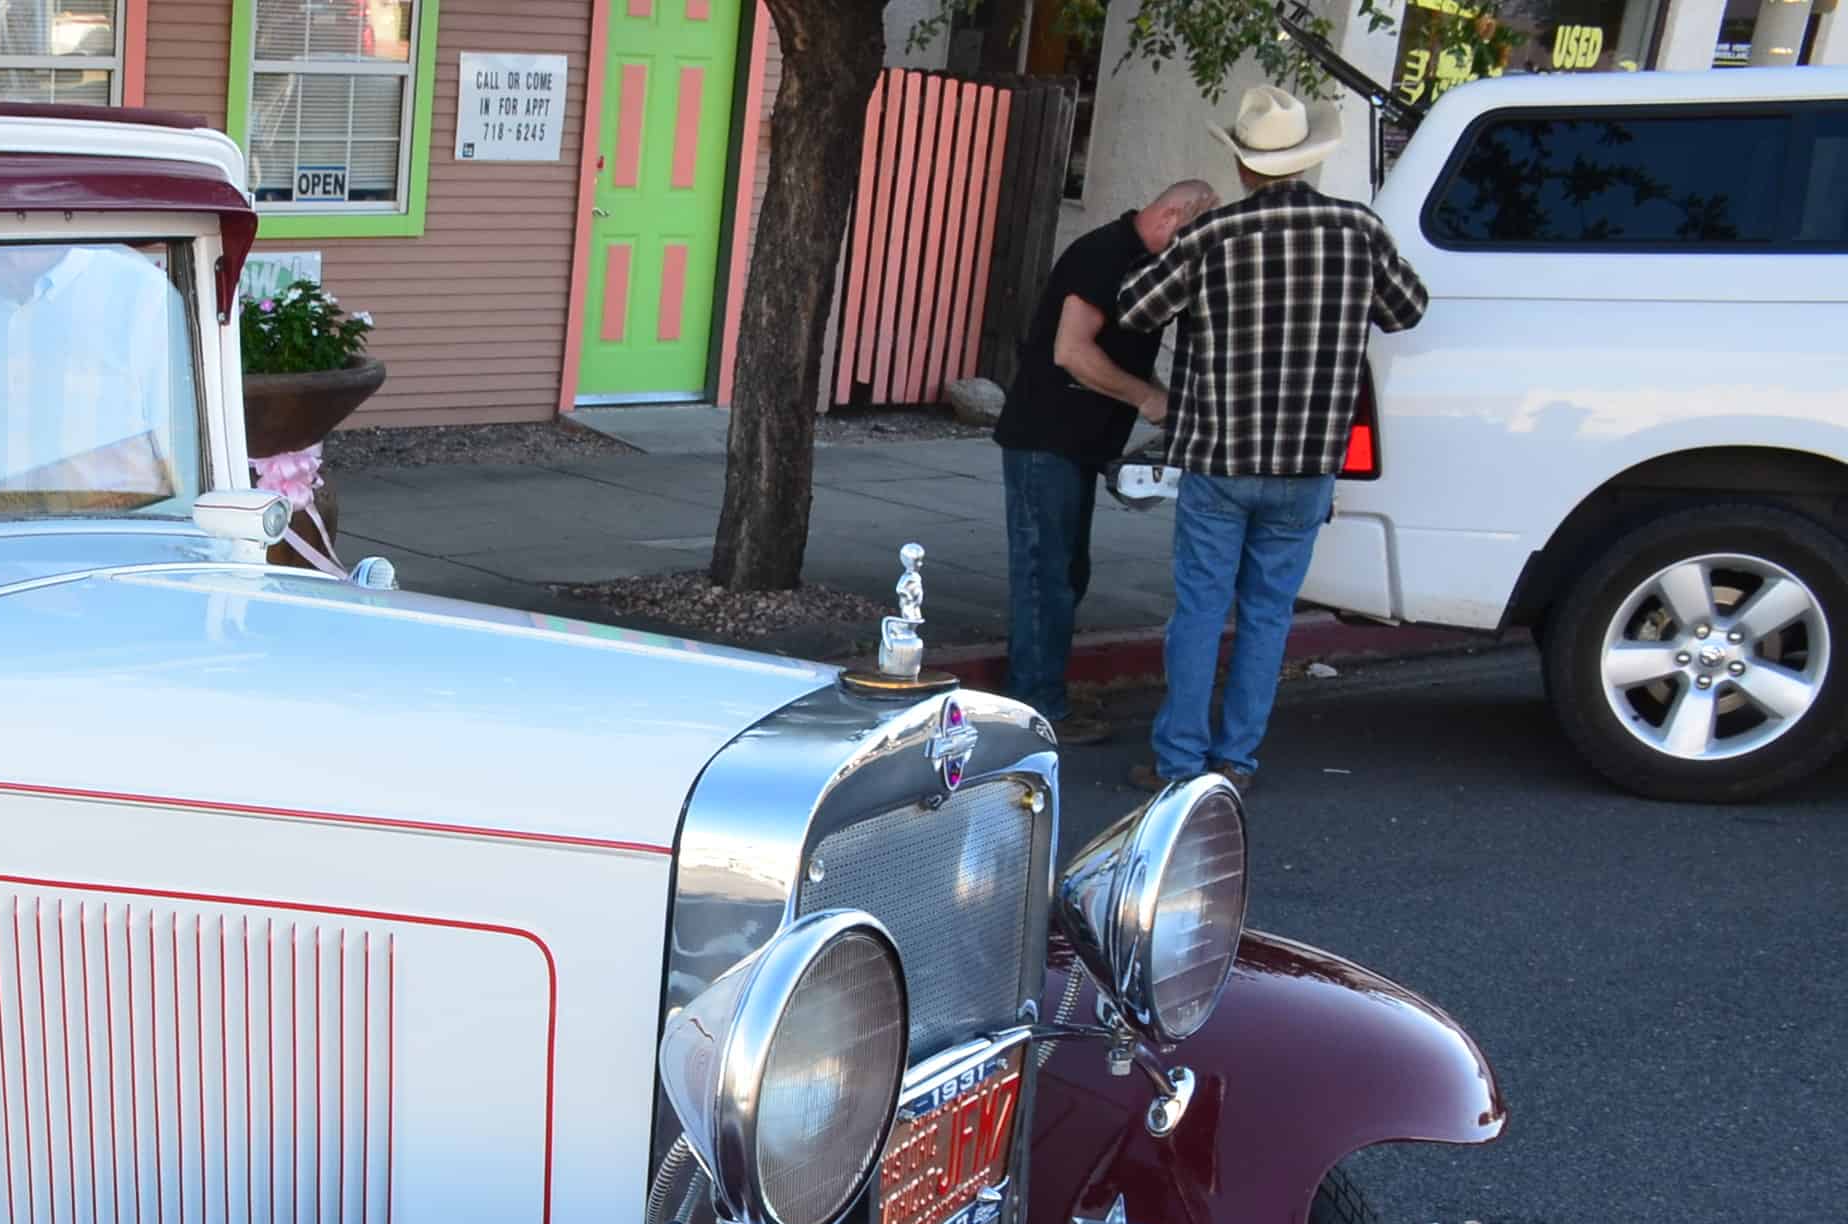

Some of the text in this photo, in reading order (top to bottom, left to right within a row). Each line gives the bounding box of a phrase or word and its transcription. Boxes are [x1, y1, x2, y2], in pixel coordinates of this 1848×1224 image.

[1553, 25, 1603, 69] USED
[476, 71, 552, 91] CALL OR COME
[480, 97, 550, 117] IN FOR APPT
[298, 173, 345, 195] OPEN
